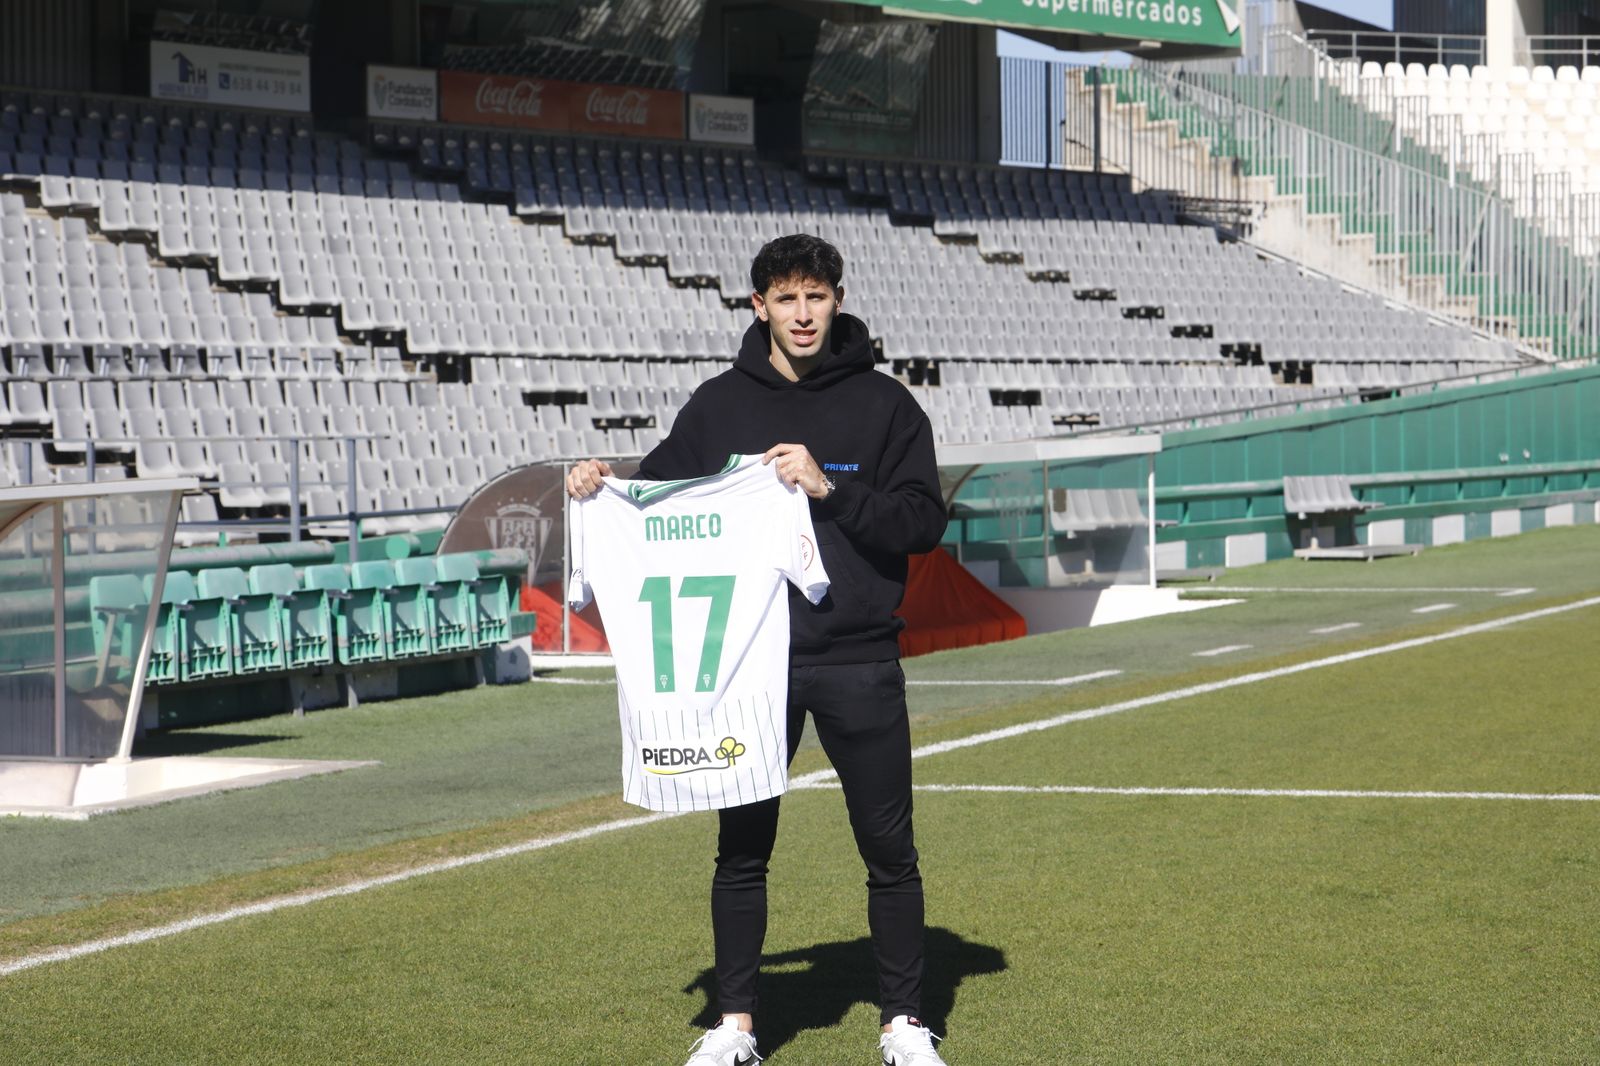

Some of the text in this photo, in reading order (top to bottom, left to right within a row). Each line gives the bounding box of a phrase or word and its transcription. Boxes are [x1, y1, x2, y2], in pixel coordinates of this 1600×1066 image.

[824, 463, 859, 471] PRIVATE
[645, 513, 721, 541] MARCO
[638, 575, 736, 692] 17
